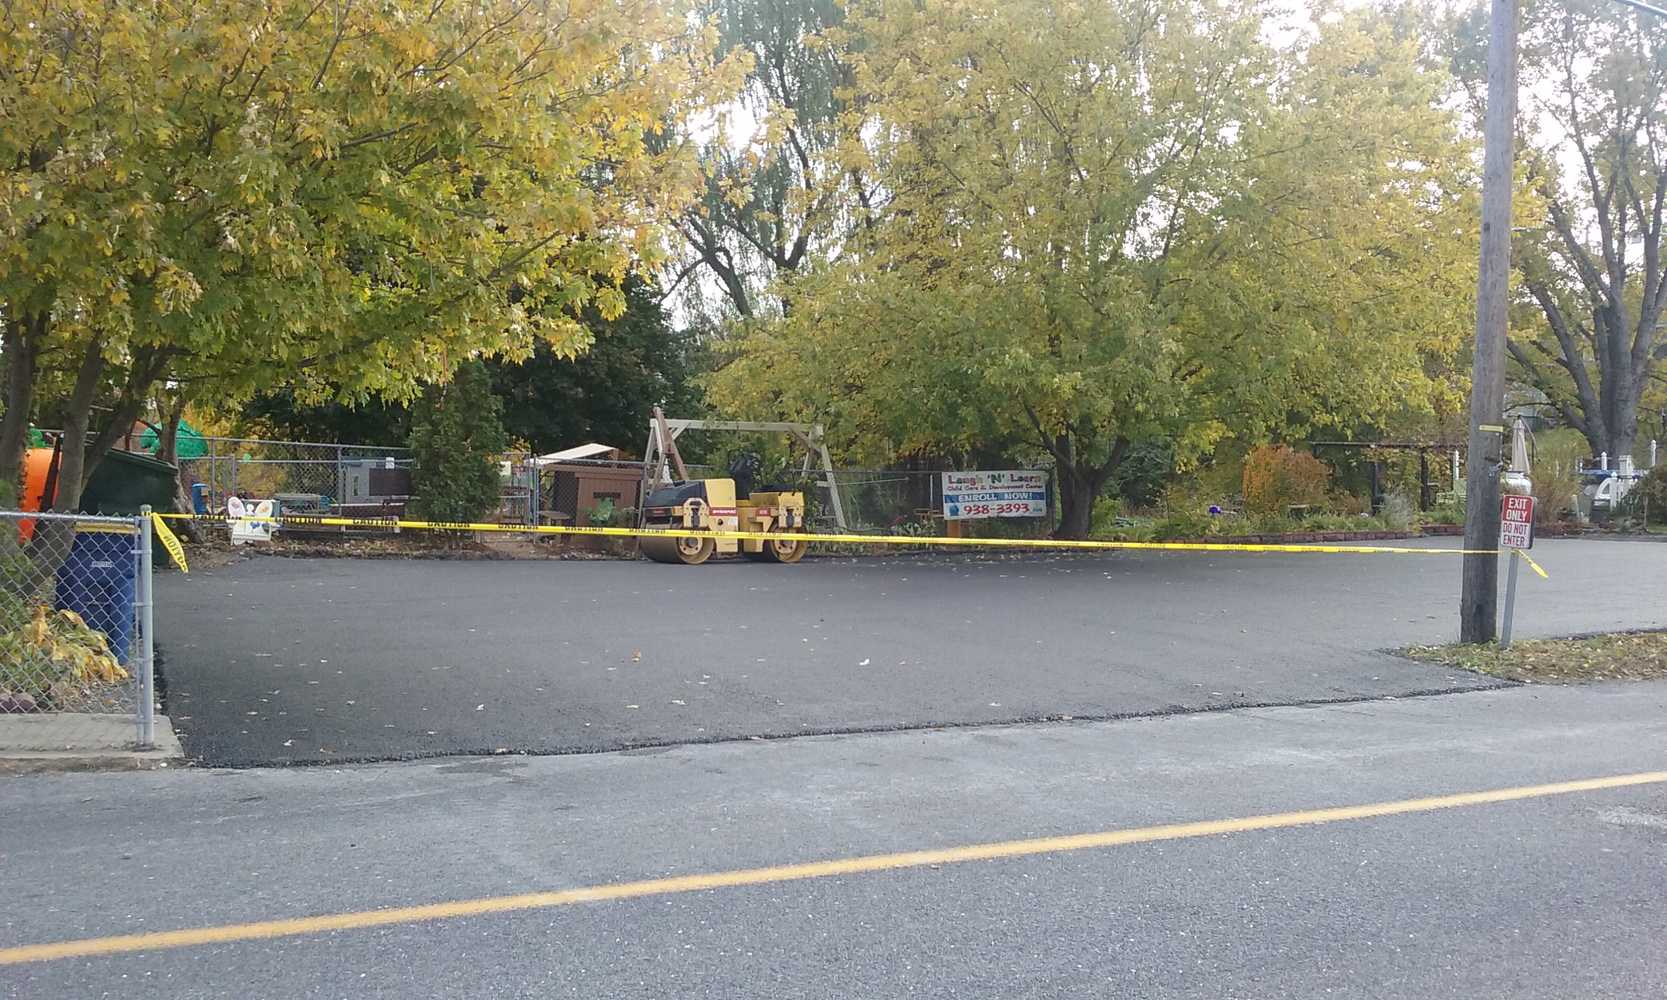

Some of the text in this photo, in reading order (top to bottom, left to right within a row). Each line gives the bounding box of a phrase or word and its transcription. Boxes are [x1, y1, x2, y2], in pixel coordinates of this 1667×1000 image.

[1010, 474, 1041, 482] Learn
[959, 492, 1033, 502] ENROLL NOW!
[964, 503, 1029, 515] 938-3393
[1509, 498, 1527, 509] EXIT
[1506, 509, 1528, 521] ONLY
[1503, 523, 1528, 535] DO NOT
[1503, 535, 1525, 547] ENTER
